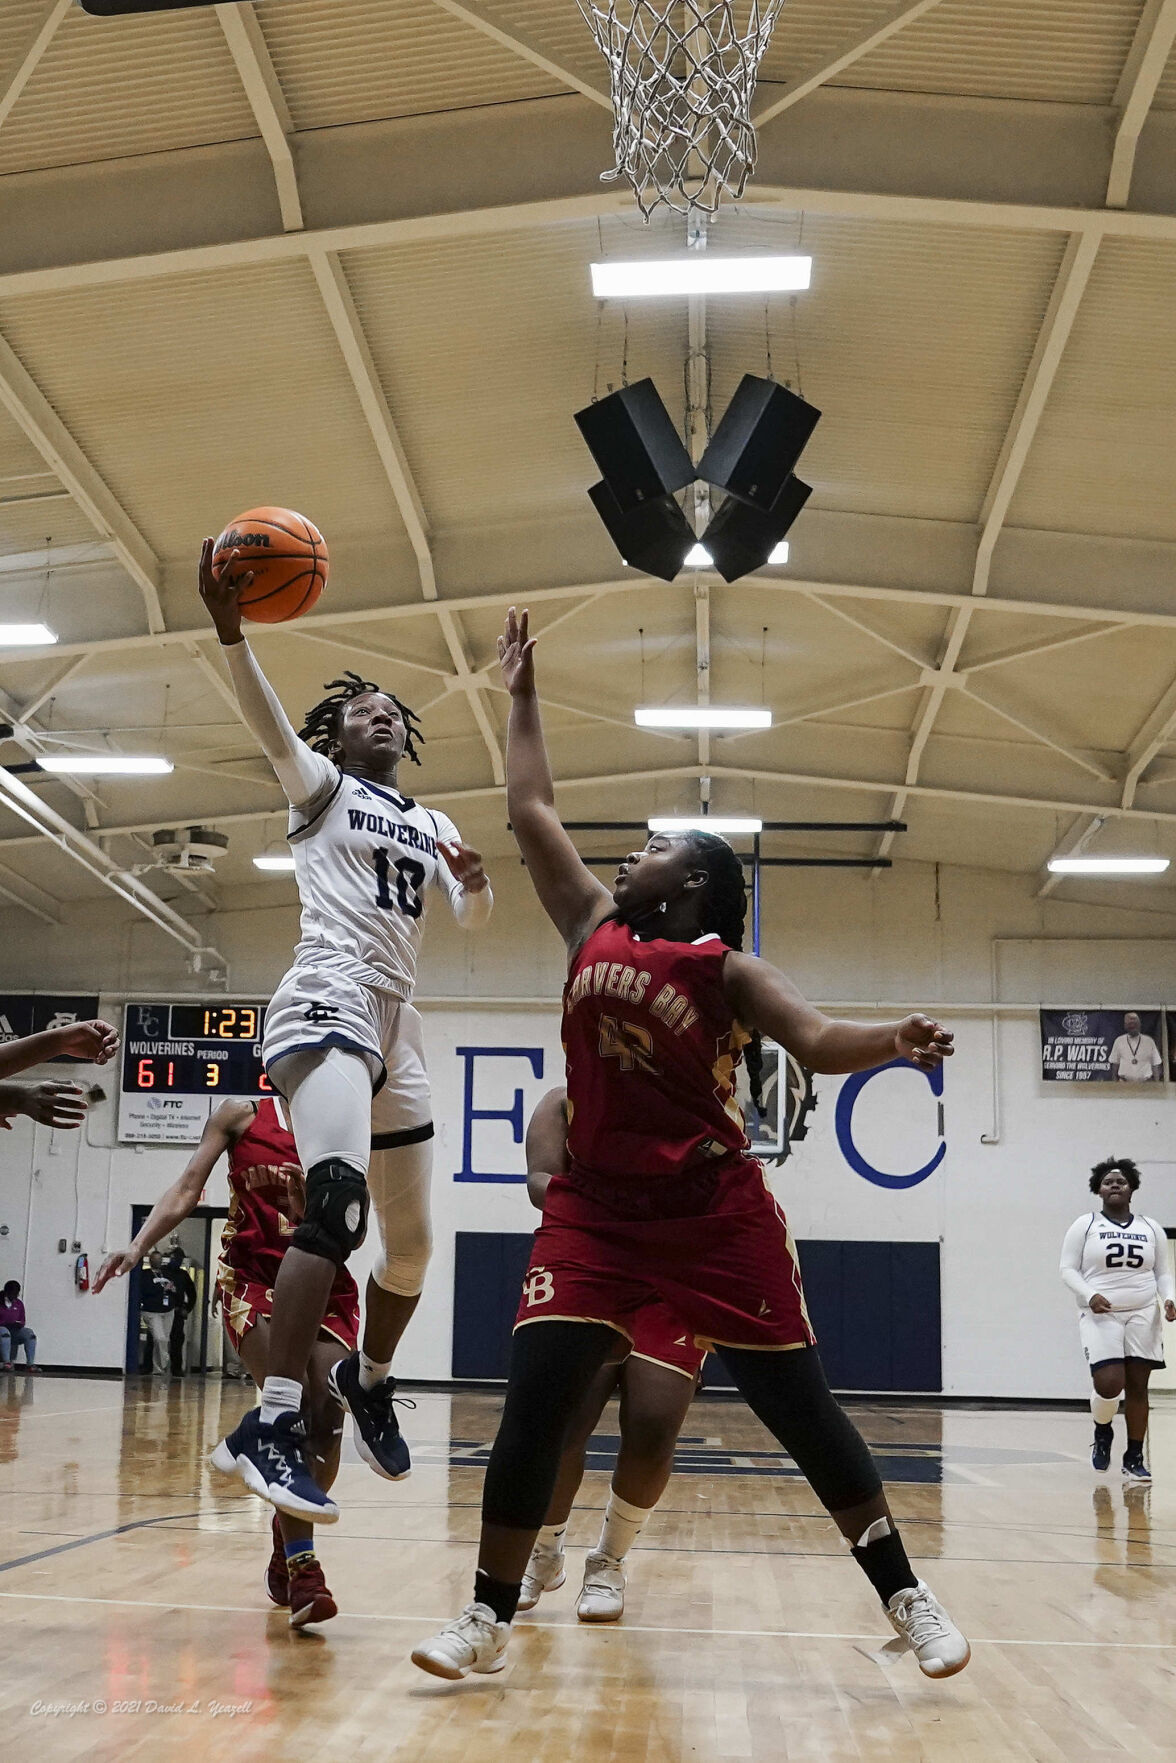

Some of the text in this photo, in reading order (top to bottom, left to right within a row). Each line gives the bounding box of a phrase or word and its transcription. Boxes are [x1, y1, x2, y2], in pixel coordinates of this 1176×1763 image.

[373, 847, 426, 919] 10
[648, 983, 700, 1036] BAY
[203, 1009, 255, 1038] 1:23
[129, 1041, 195, 1056] WOLVERINES
[197, 1050, 229, 1060] PERIOD
[1068, 1045, 1108, 1062] WATTS
[206, 1063, 219, 1087] 3
[163, 1100, 183, 1109] FTC
[1105, 1243, 1144, 1269] 25
